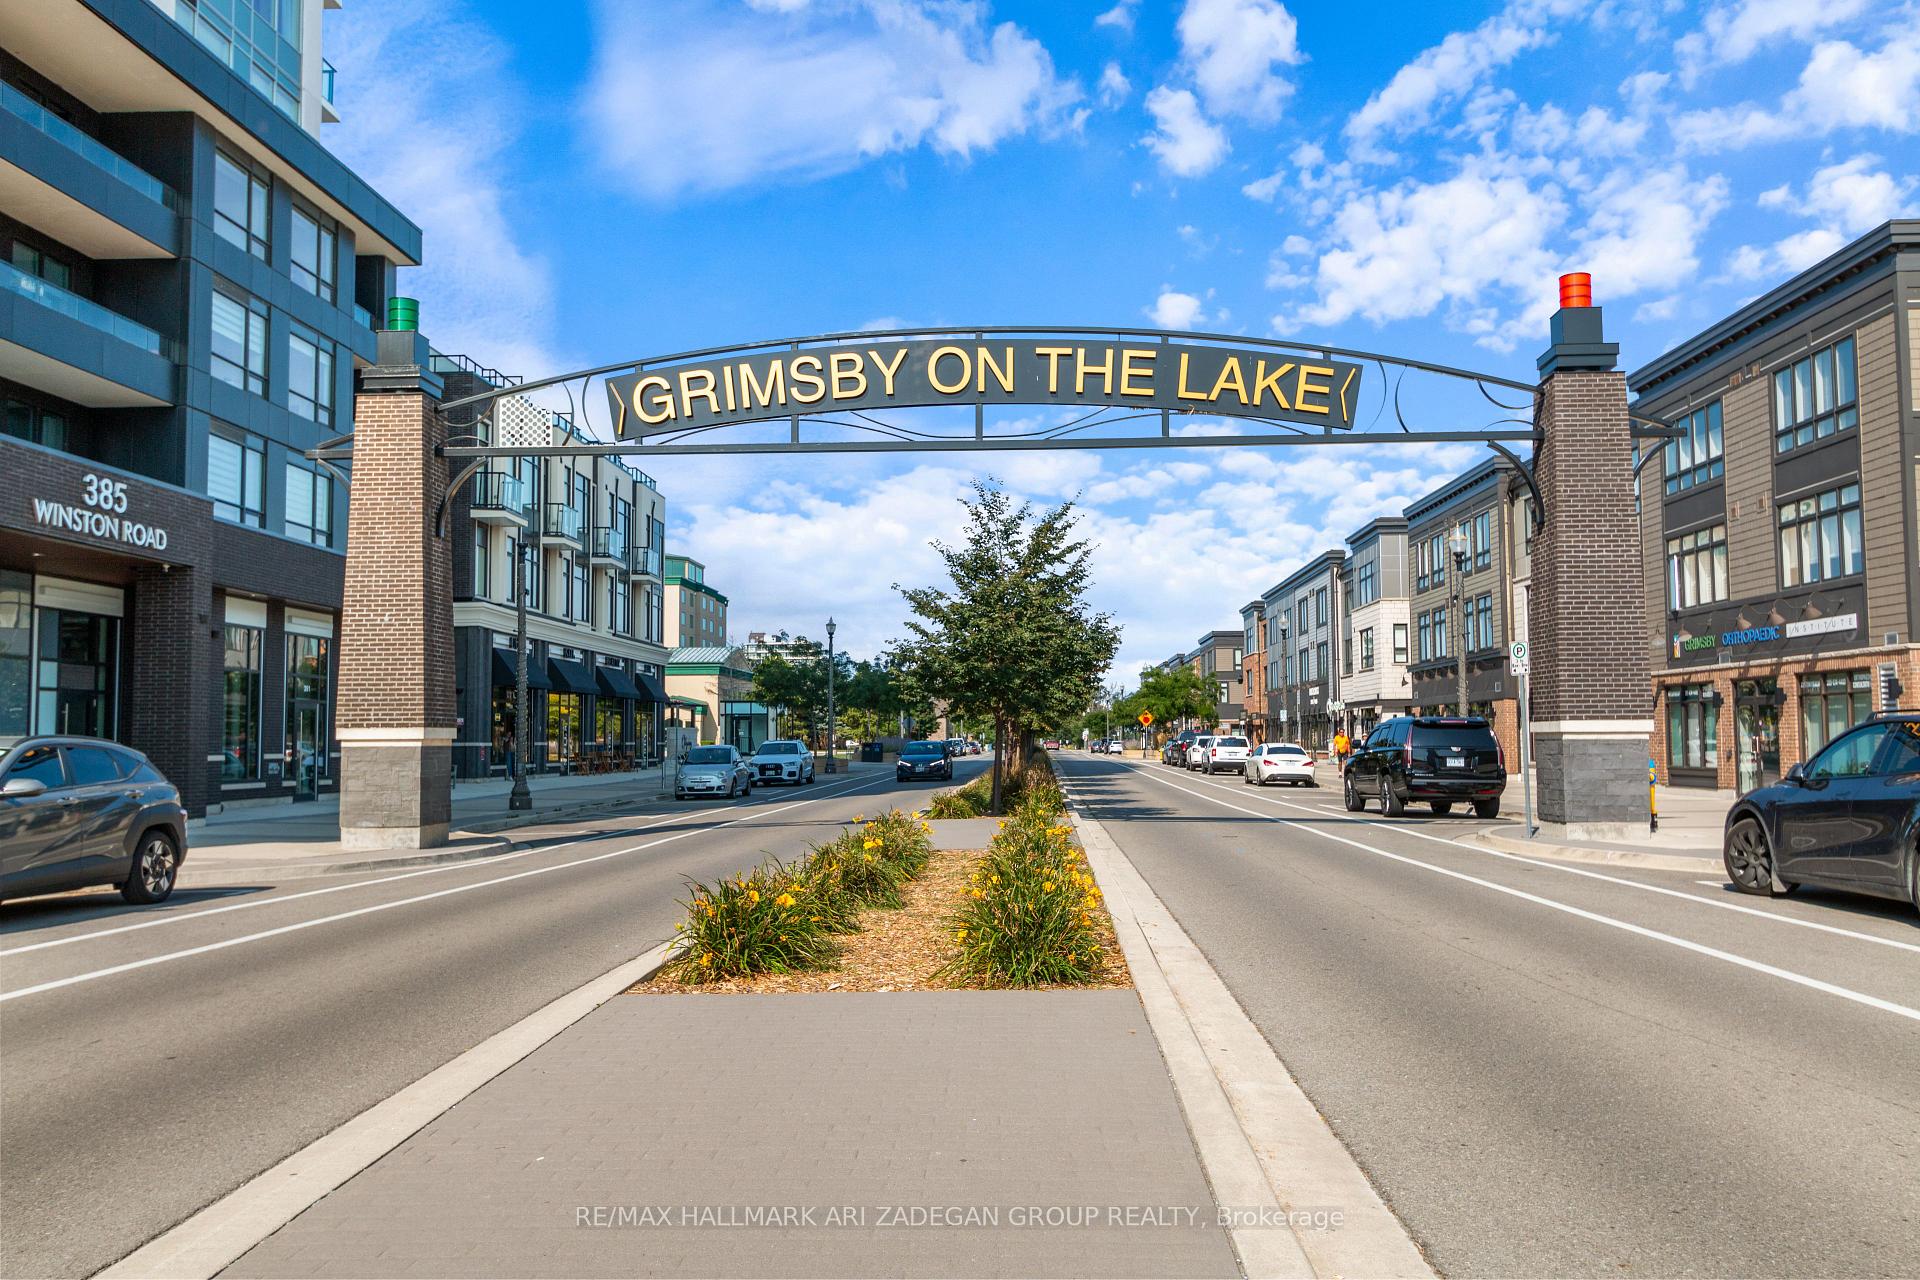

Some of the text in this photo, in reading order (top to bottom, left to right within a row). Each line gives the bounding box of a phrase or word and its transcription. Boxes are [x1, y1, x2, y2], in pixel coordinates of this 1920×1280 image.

[632, 346, 1335, 424] GRIMSBY ON THE LAKE
[82, 473, 128, 514] 385
[33, 498, 167, 551] WINSTON ROAD
[1516, 646, 1523, 656] P
[1684, 618, 1854, 651] GRIMSBY ORTHOPAEDIC INSTITUTE
